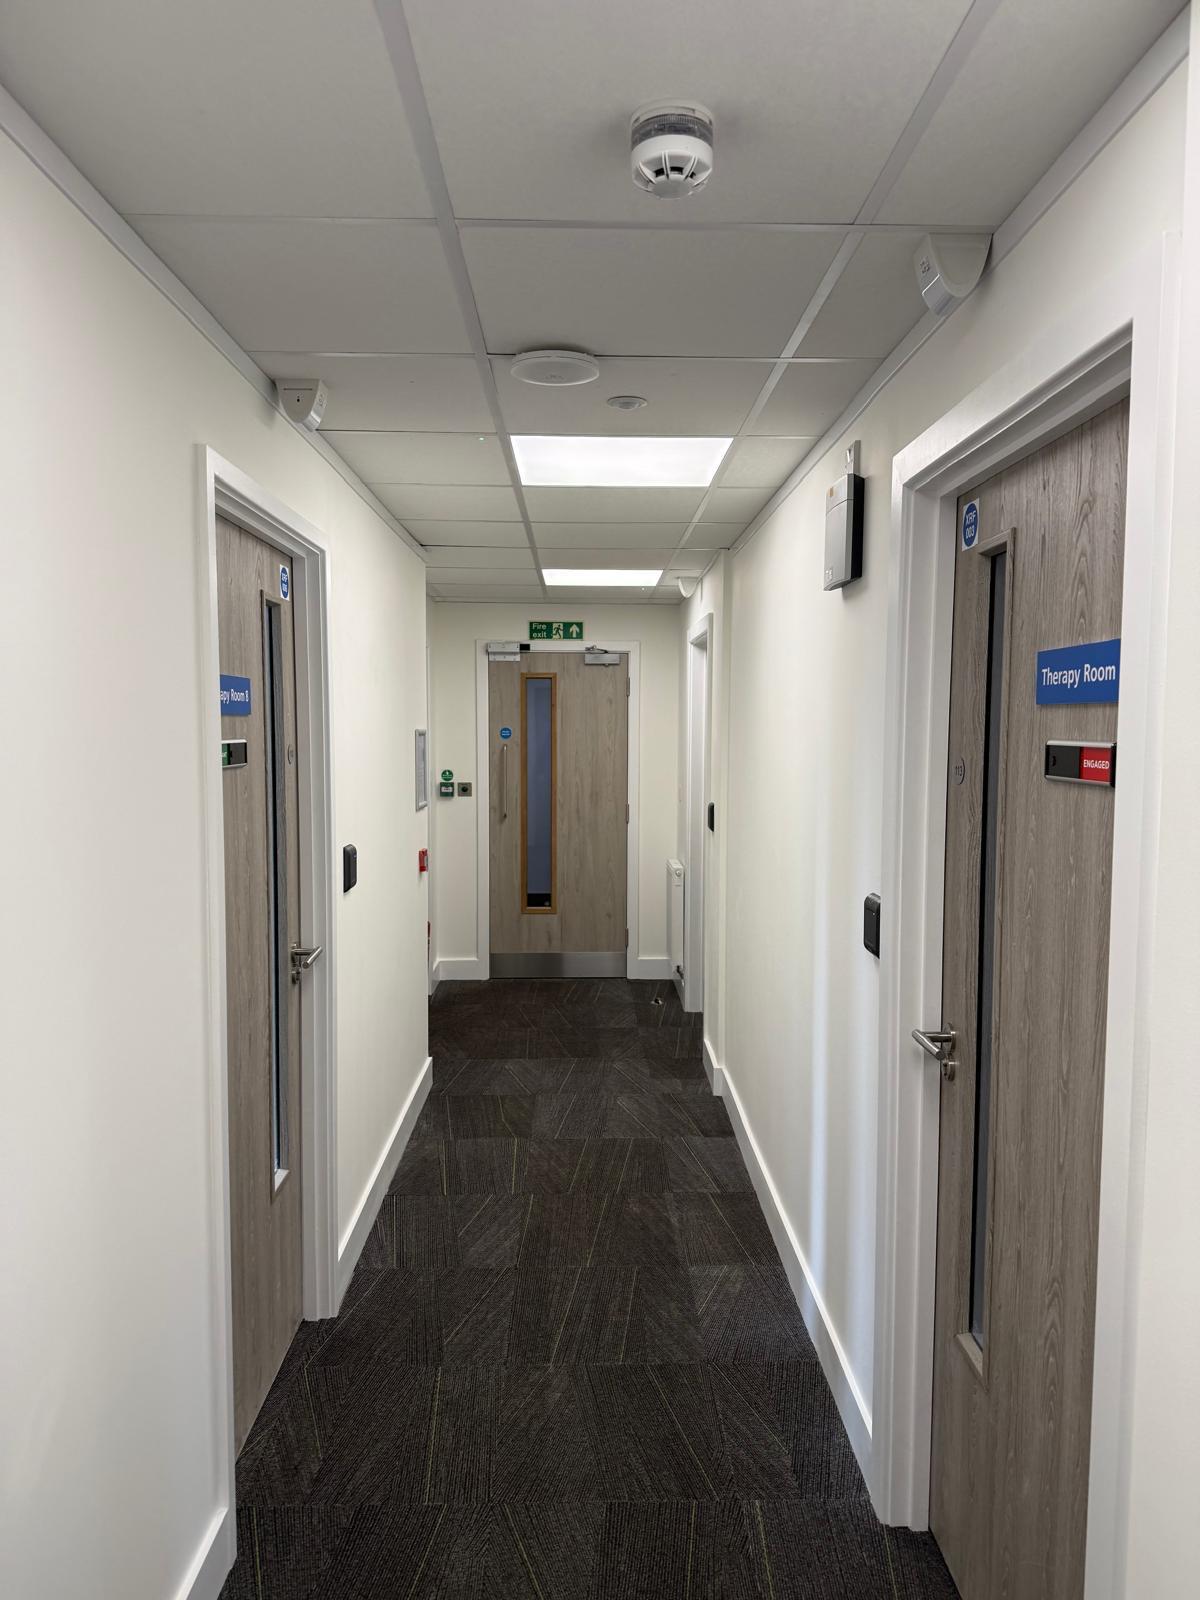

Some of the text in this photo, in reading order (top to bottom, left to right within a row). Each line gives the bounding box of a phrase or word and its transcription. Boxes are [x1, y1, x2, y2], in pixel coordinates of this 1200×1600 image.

[1041, 663, 1116, 689] Therapy Room
[230, 688, 245, 702] Room
[1083, 759, 1110, 770] ENGAGED
